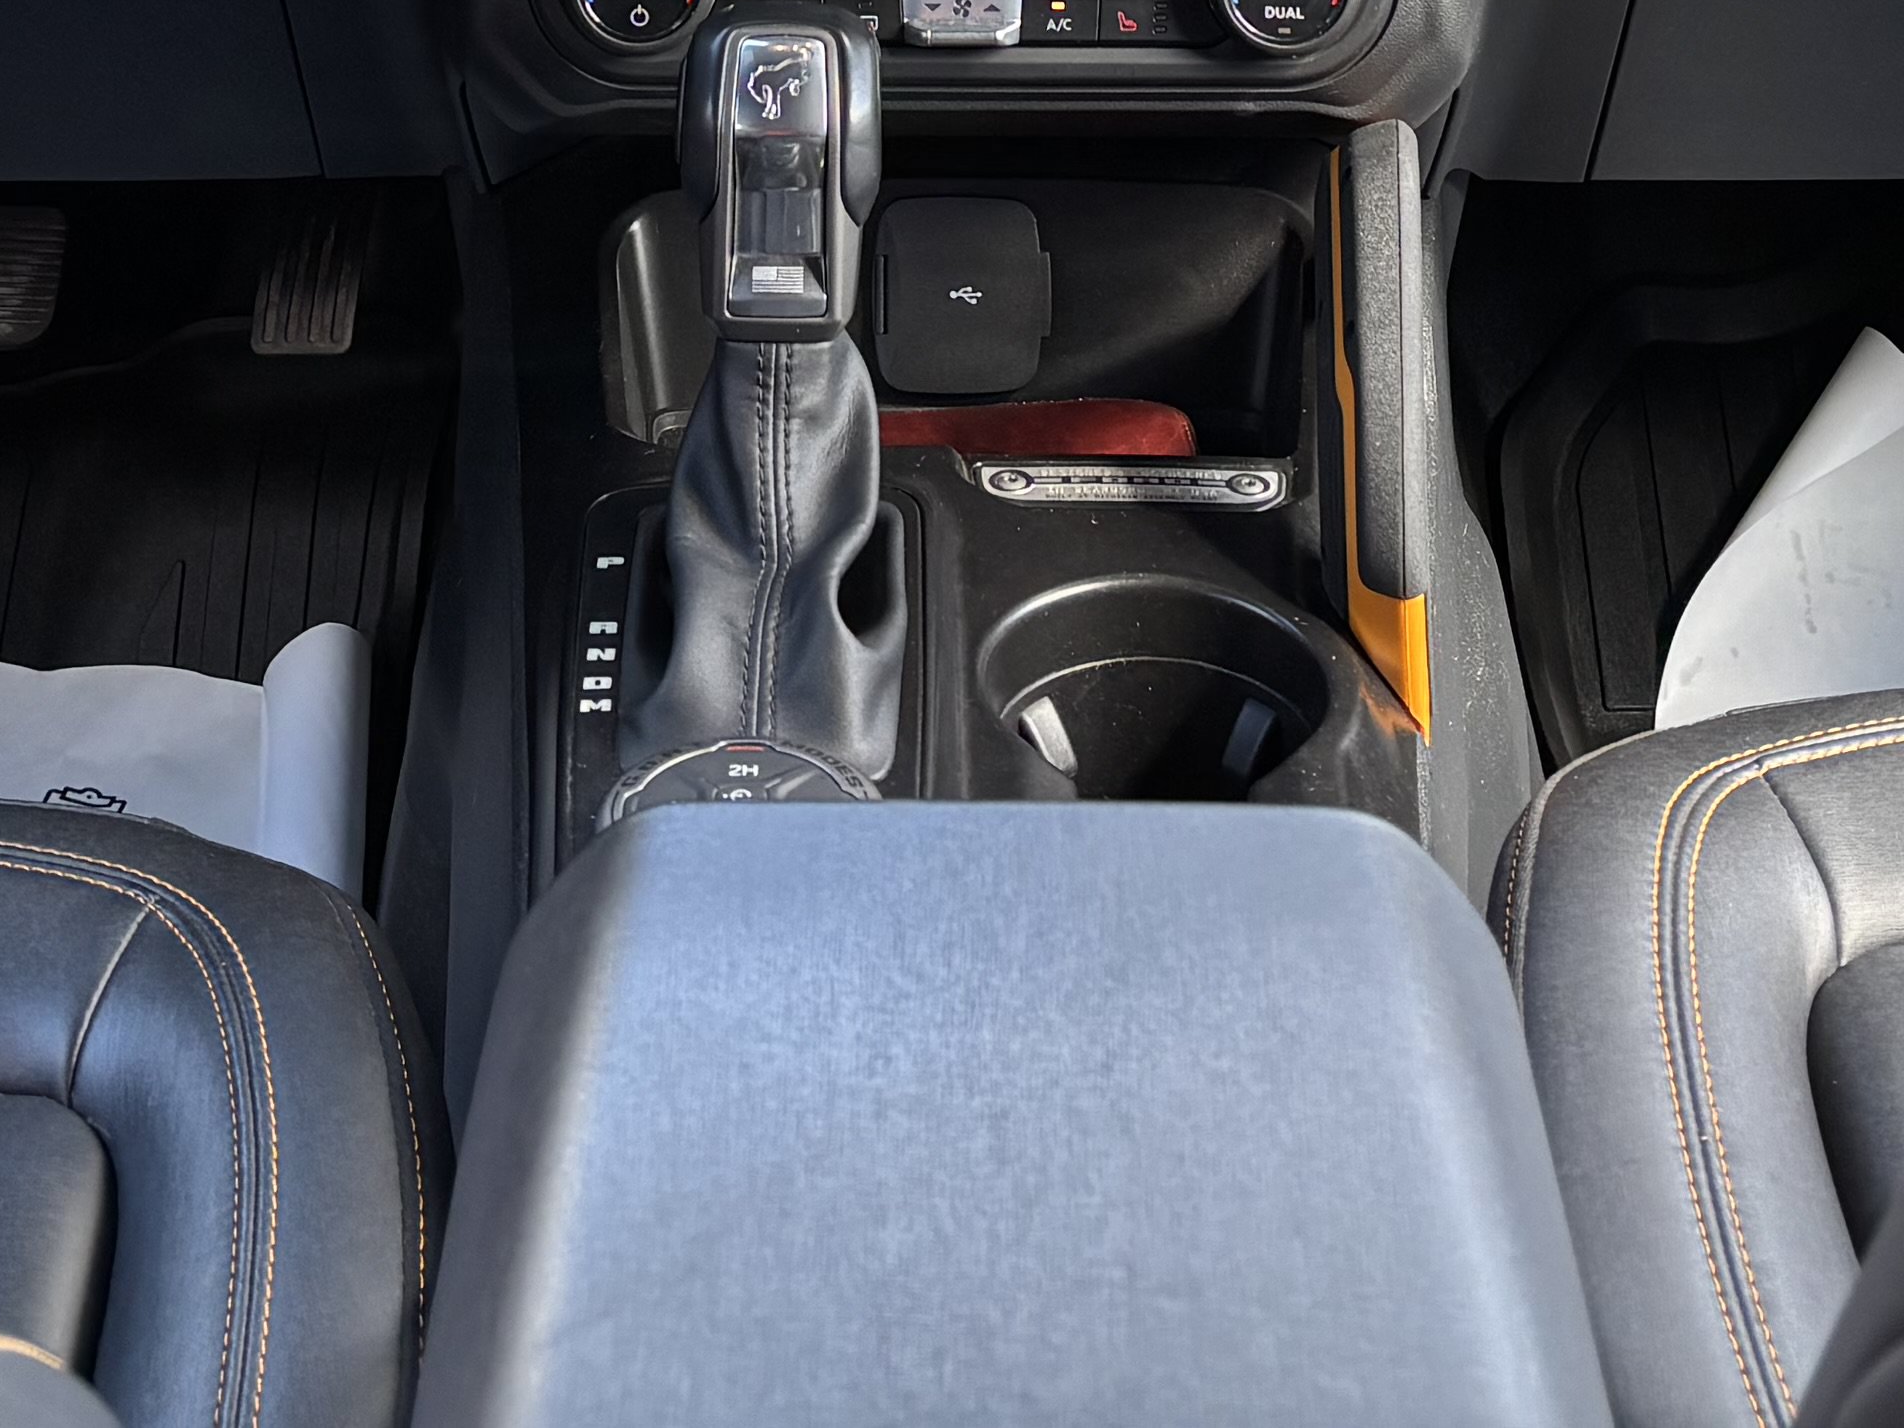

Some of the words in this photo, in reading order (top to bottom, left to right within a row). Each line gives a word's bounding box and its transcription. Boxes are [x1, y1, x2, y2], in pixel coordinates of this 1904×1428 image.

[1264, 5, 1304, 20] DUAL
[1046, 18, 1072, 32] A/C
[596, 556, 625, 569] P
[586, 648, 616, 661] N
[579, 698, 612, 713] M
[728, 763, 759, 777] 2H
